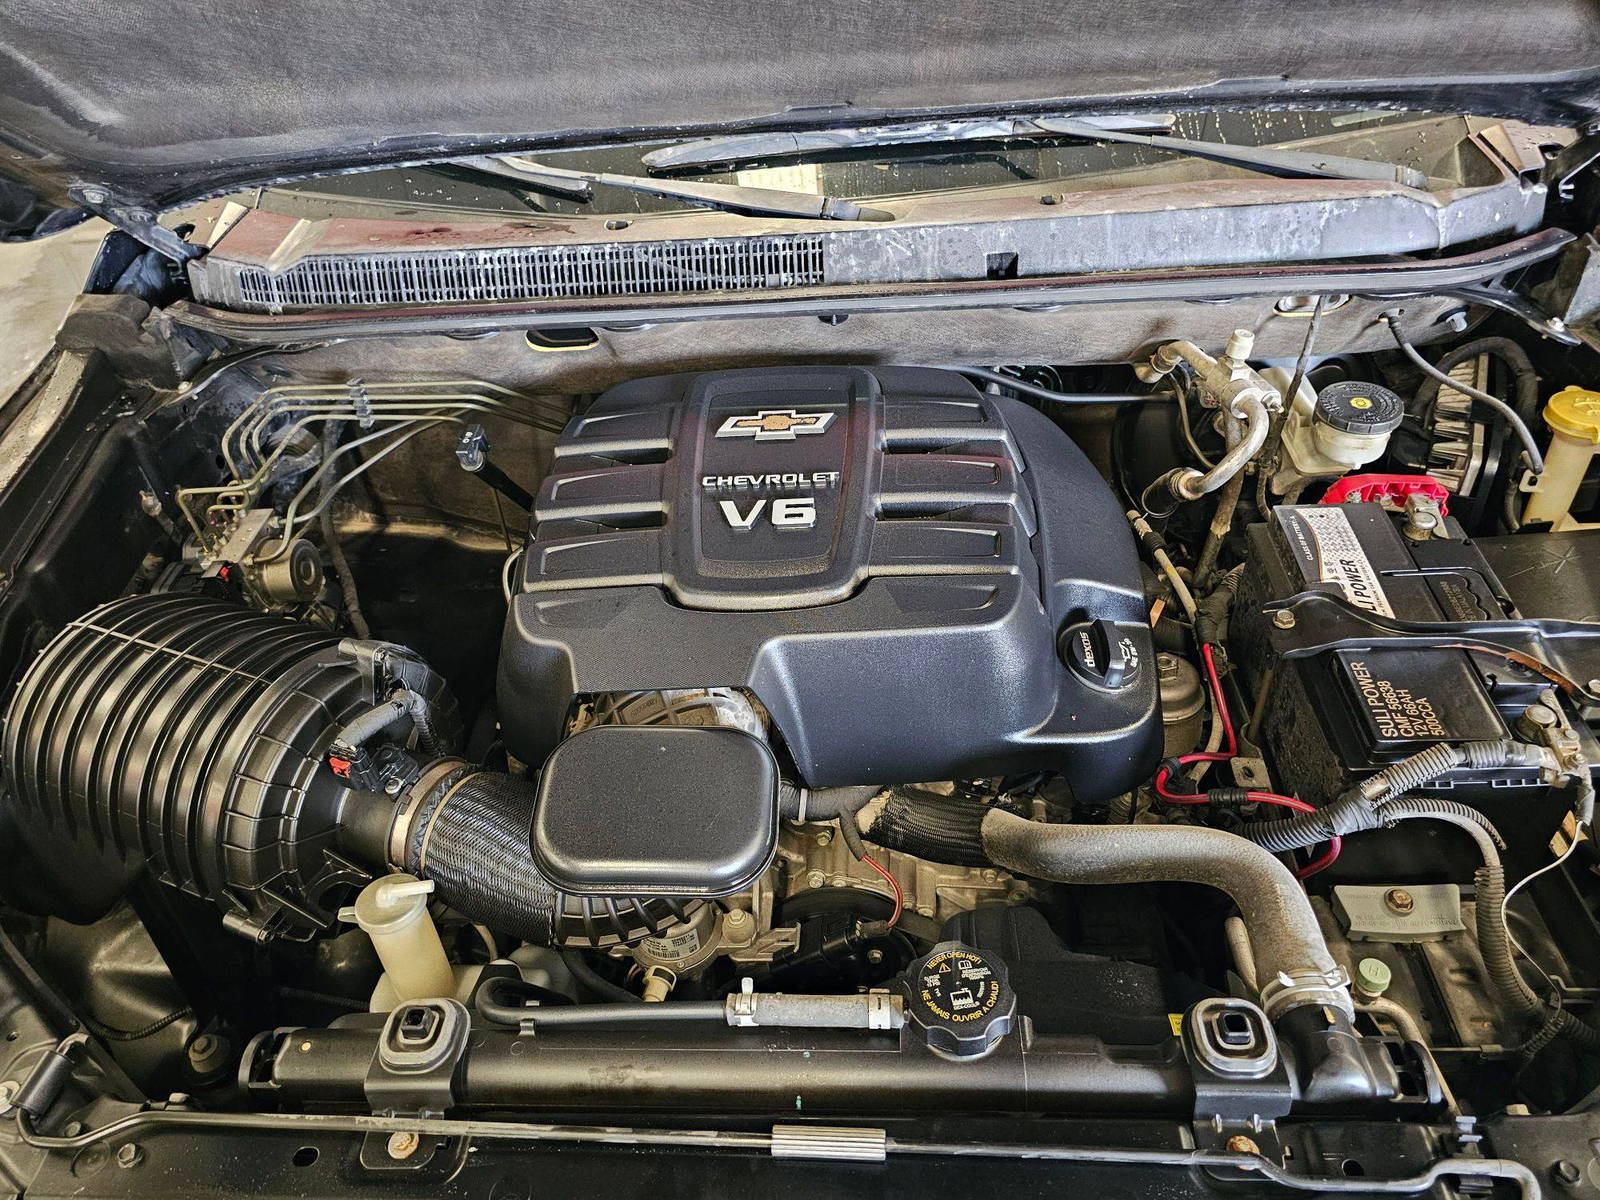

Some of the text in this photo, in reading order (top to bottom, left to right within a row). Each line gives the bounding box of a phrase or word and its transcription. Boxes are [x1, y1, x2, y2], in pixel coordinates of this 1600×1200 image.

[702, 471, 840, 490] CHEVROLET
[719, 497, 816, 530] V6
[1340, 560, 1371, 598] POWER
[1080, 631, 1096, 667] dexos
[1350, 661, 1398, 737] SULI POWER
[1376, 680, 1415, 737] CMF 56638
[1395, 689, 1429, 736] 12V 66AH
[1415, 697, 1445, 736] 500CCA
[926, 951, 982, 970] NEVER OPEN HOT!
[921, 989, 931, 1001] NE
[926, 1000, 950, 1020] JAMAIS
[952, 1009, 984, 1022] OUVRIR
[986, 980, 999, 1008] CHAUD!
